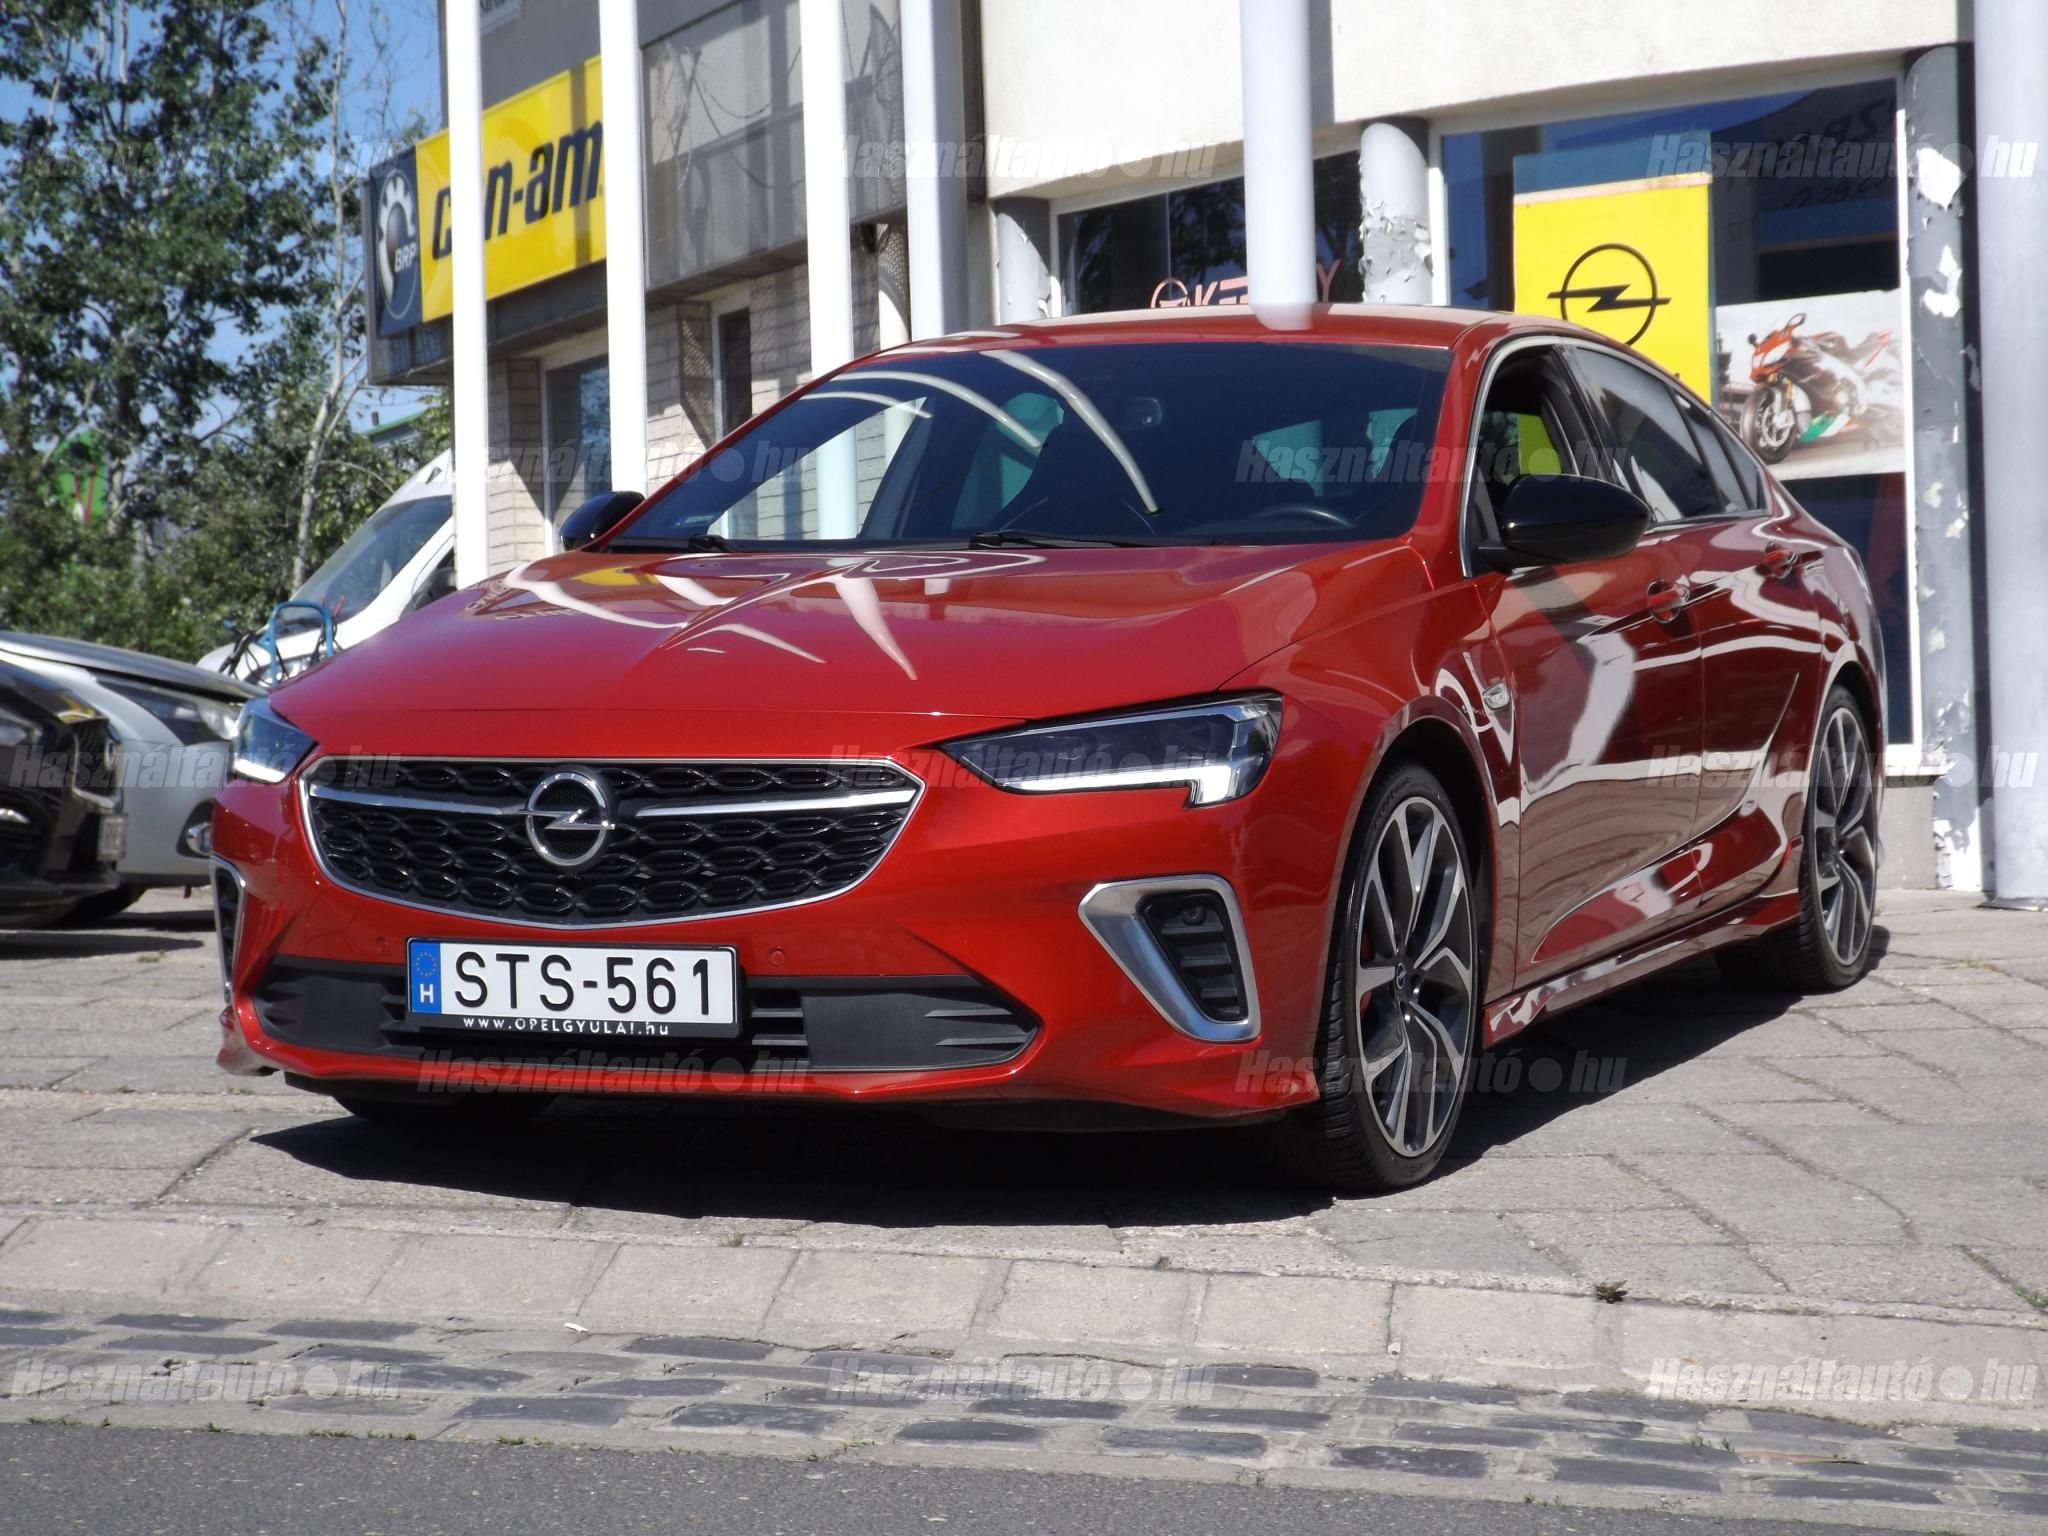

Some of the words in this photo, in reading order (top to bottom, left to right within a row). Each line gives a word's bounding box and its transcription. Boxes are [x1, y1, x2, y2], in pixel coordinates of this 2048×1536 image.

[432, 119, 602, 261] cn-am
[394, 243, 418, 272] BRP
[419, 983, 434, 1004] H
[454, 951, 710, 1016] STS-561
